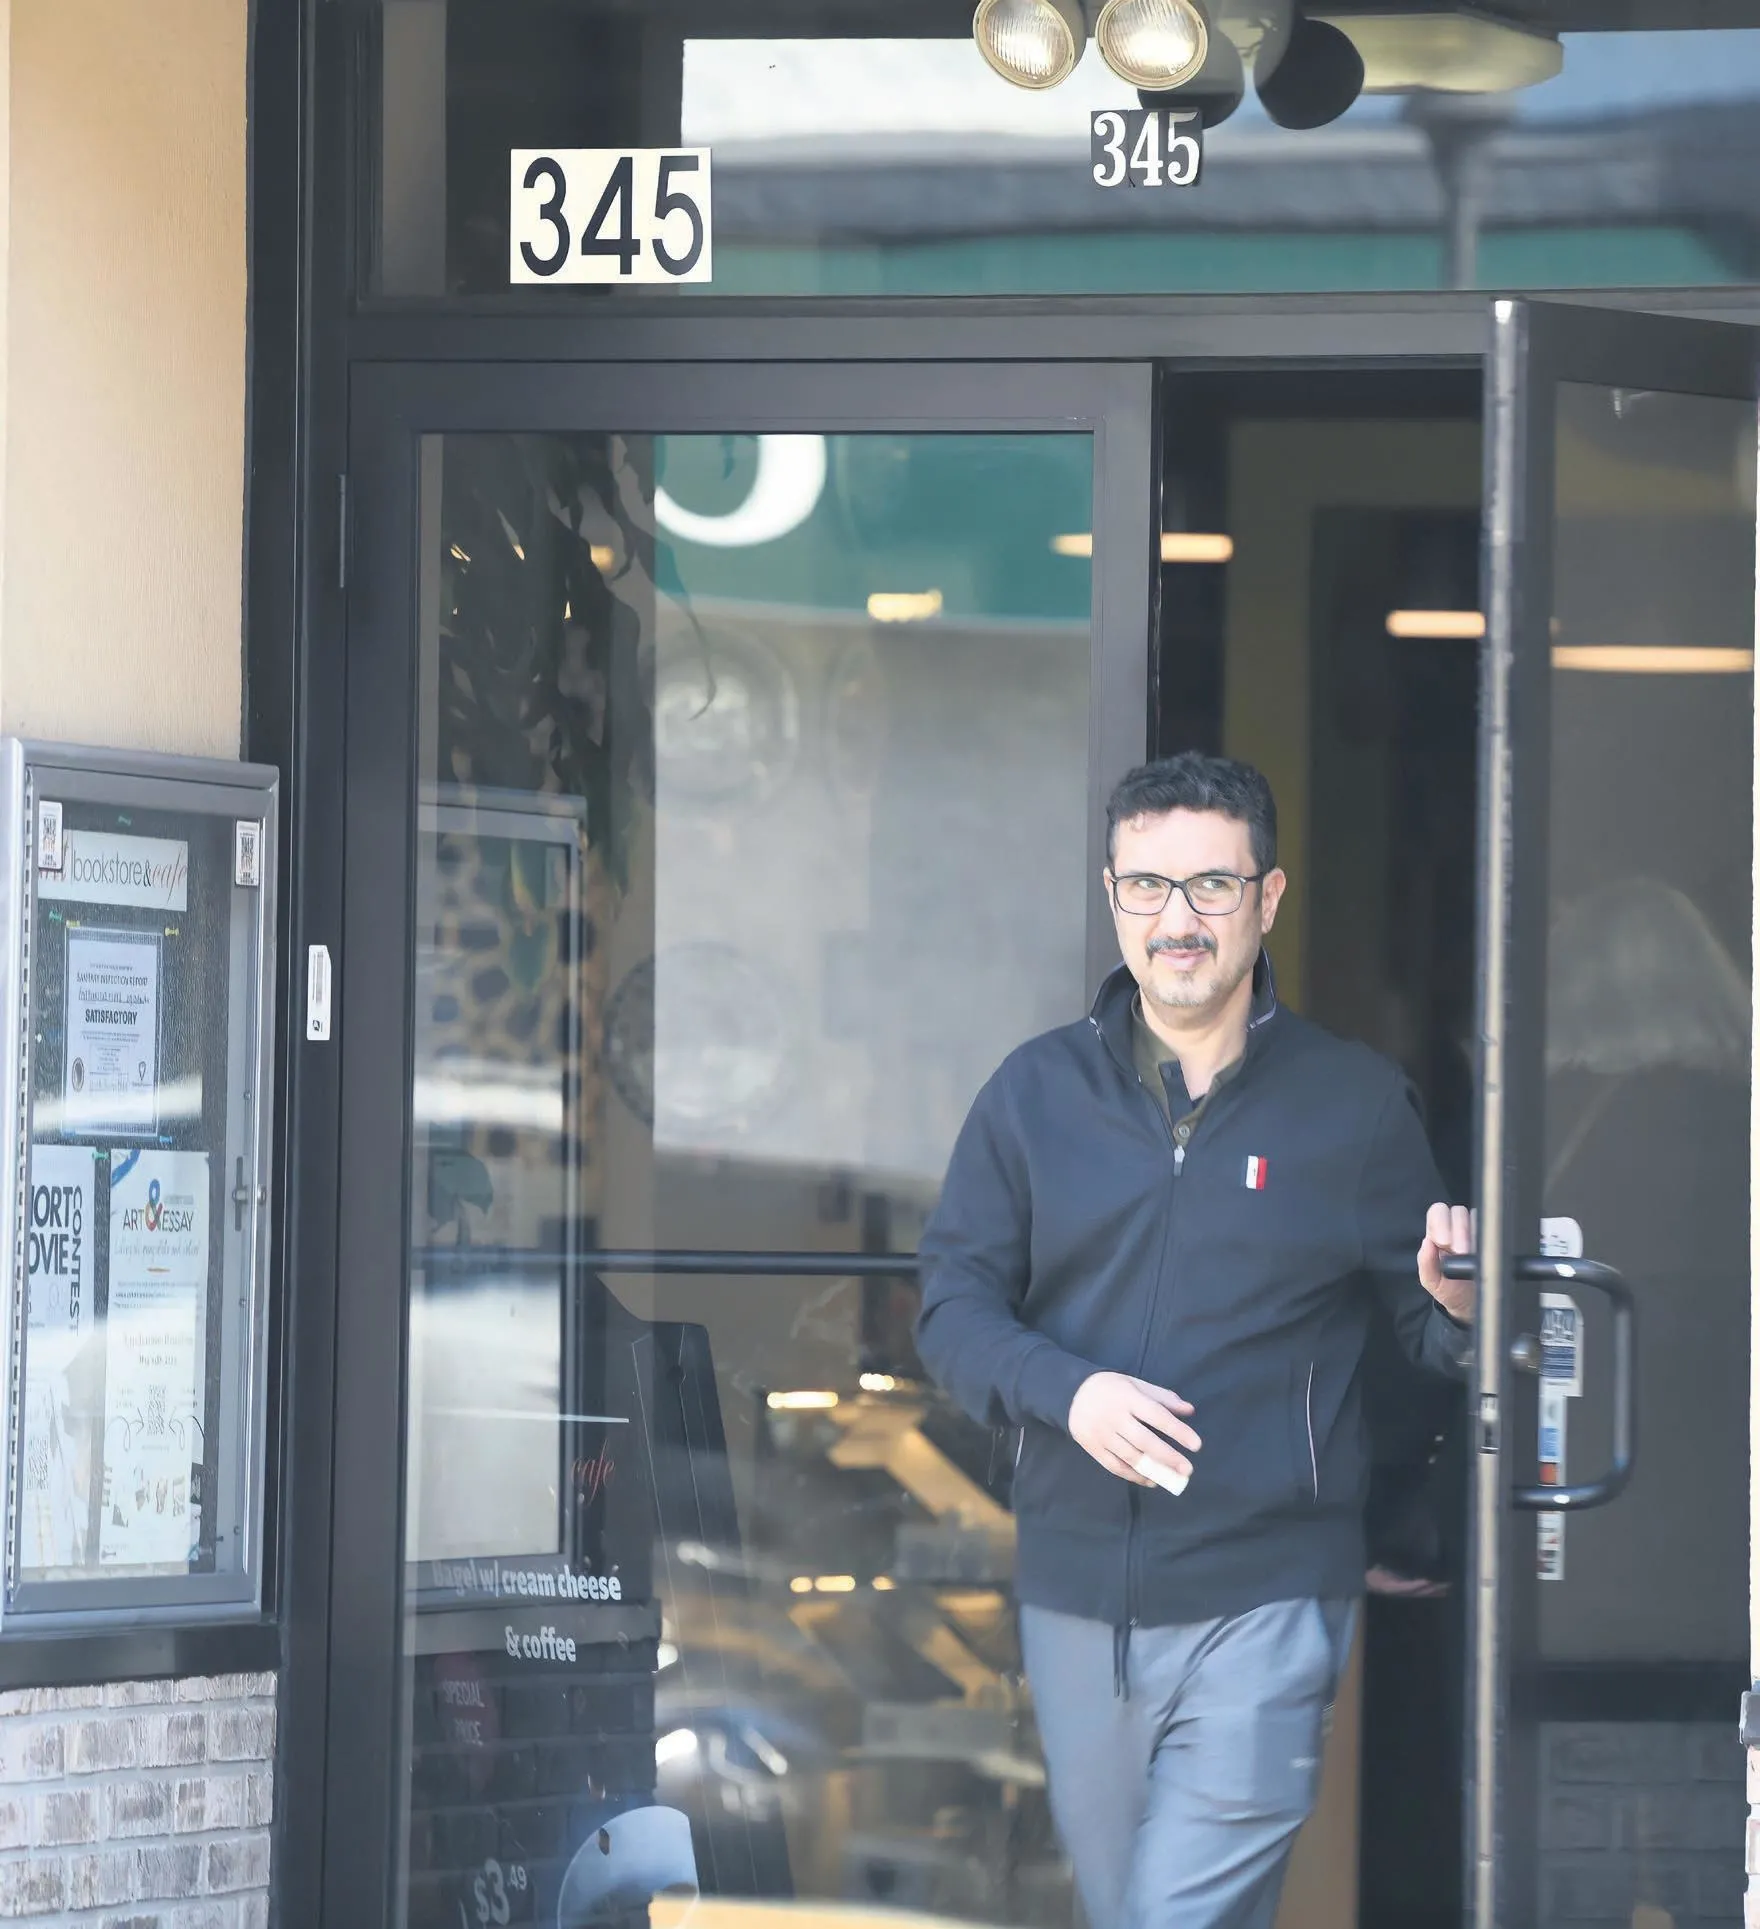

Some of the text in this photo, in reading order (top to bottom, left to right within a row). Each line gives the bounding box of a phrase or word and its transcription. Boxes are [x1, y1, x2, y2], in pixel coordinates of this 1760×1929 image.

[1092, 110, 1201, 188] 345
[520, 156, 704, 276] 345
[85, 1007, 137, 1026] SATISFACTORY
[502, 1570, 555, 1597] cream
[558, 1564, 621, 1600] cheese
[505, 1625, 577, 1662] & coffee
